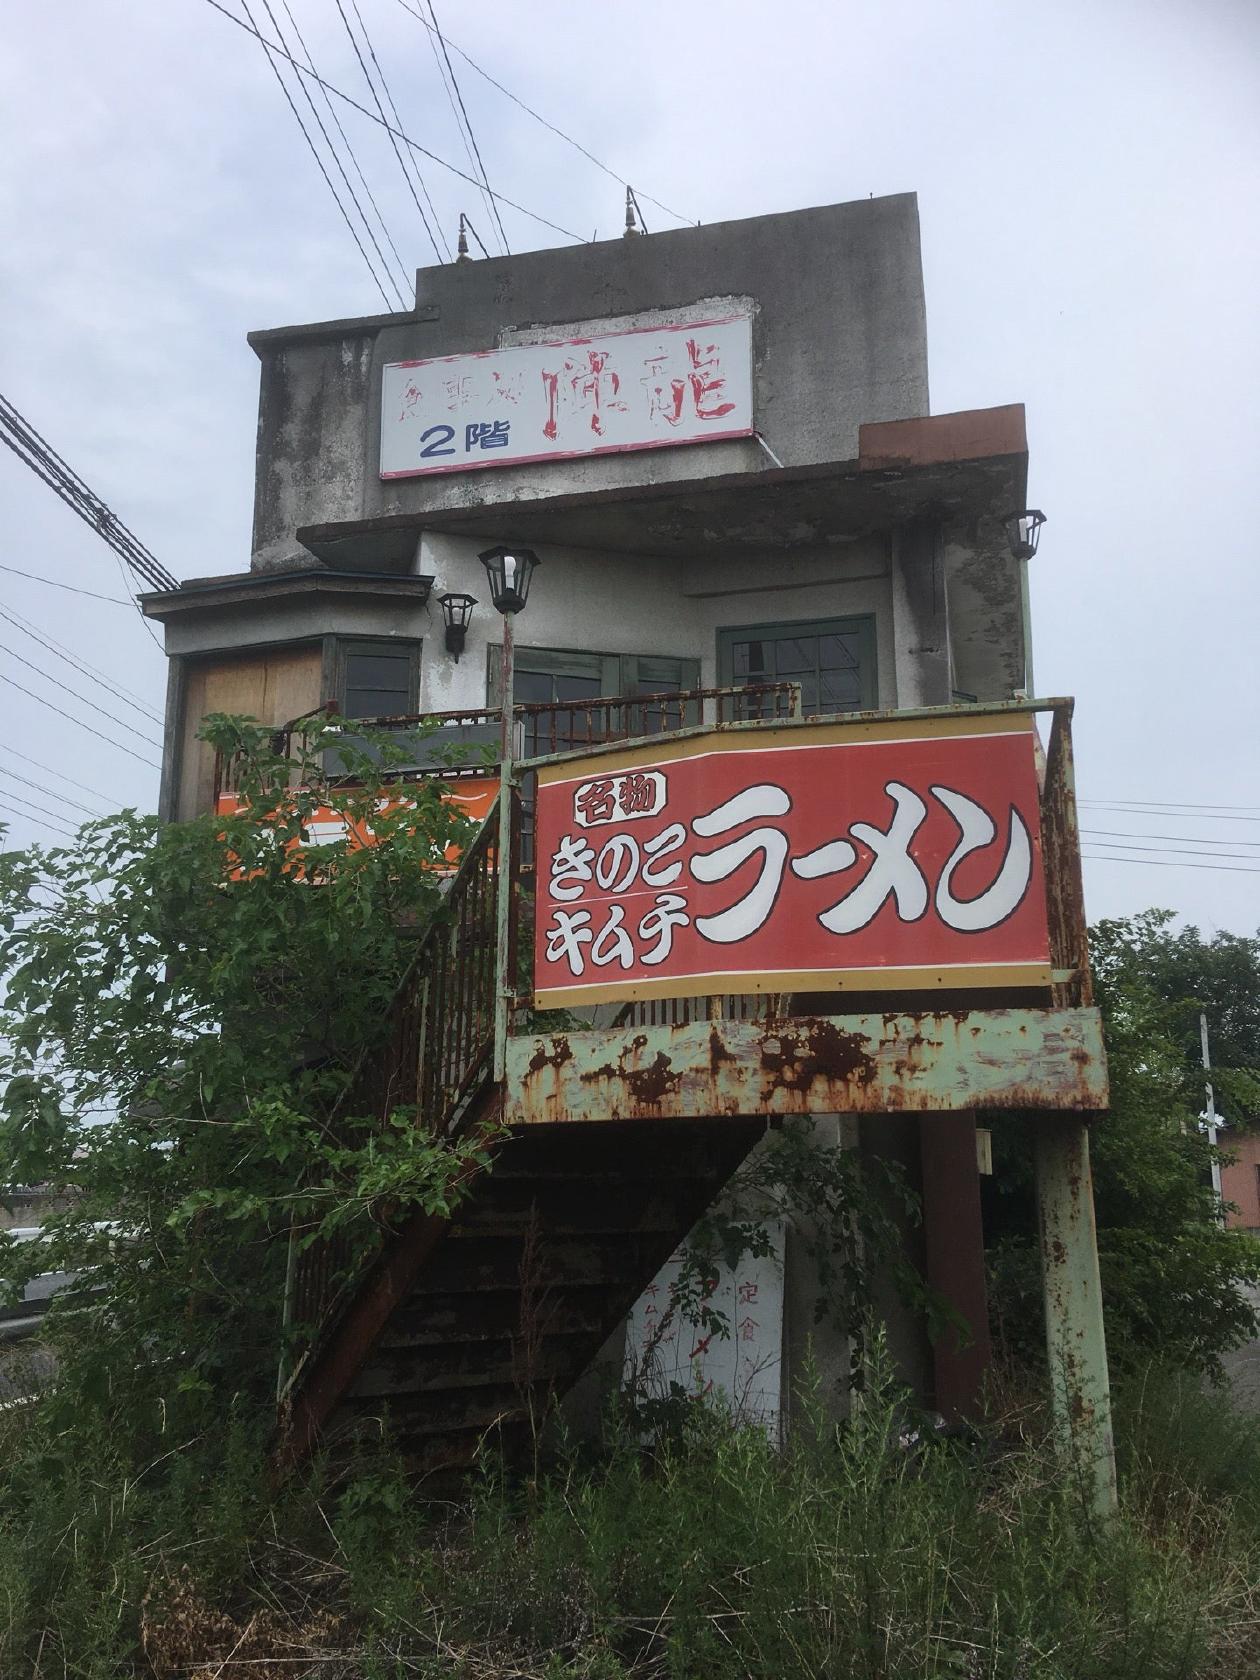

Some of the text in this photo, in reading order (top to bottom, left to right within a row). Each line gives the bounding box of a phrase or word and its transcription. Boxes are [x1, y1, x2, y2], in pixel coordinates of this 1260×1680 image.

[420, 420, 511, 458] 2階
[576, 774, 658, 823] 名物
[547, 822, 688, 902] きのこ
[689, 780, 1034, 944] ラーメン
[545, 894, 691, 977] キムチ
